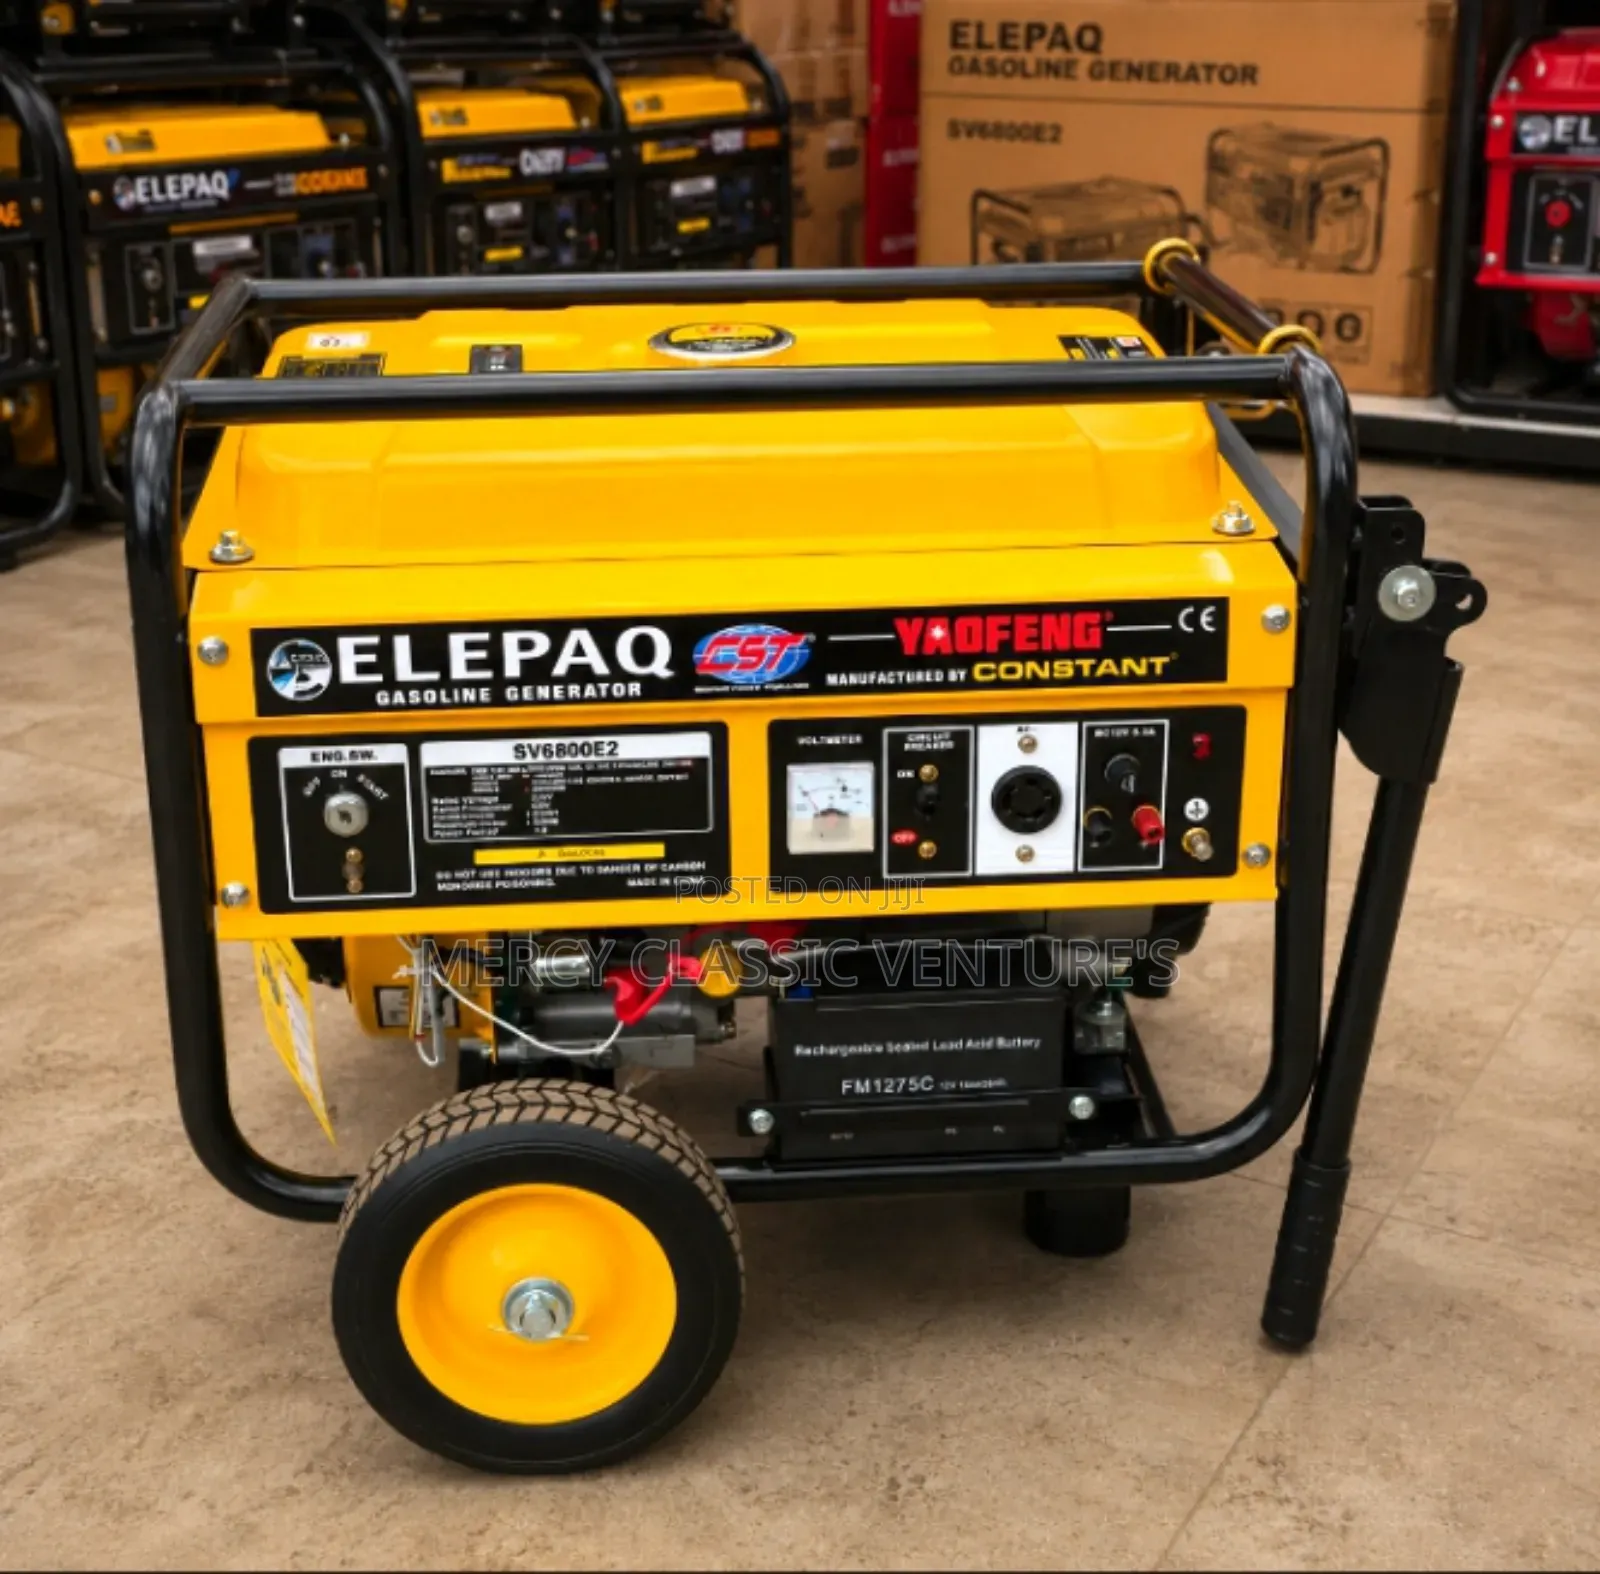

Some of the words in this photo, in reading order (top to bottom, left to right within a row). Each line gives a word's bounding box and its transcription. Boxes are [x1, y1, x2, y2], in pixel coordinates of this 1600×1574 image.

[950, 19, 1104, 54] ELEPAQ
[948, 55, 1079, 80] GASOLINE
[1088, 59, 1259, 86] GENERATOR
[134, 169, 230, 203] ELEPAQ
[893, 611, 1103, 655] YAOFENG
[337, 625, 675, 684] ELEPAQ
[694, 633, 808, 675] CST
[826, 670, 944, 686] MANUFACTURED
[948, 669, 967, 682] BY
[972, 656, 1171, 682] CONSTANT
[376, 687, 491, 706] GASOLINE
[505, 682, 642, 702] GENERATOR
[513, 741, 620, 760] SV6800E2
[842, 1075, 934, 1095] FM1275C
